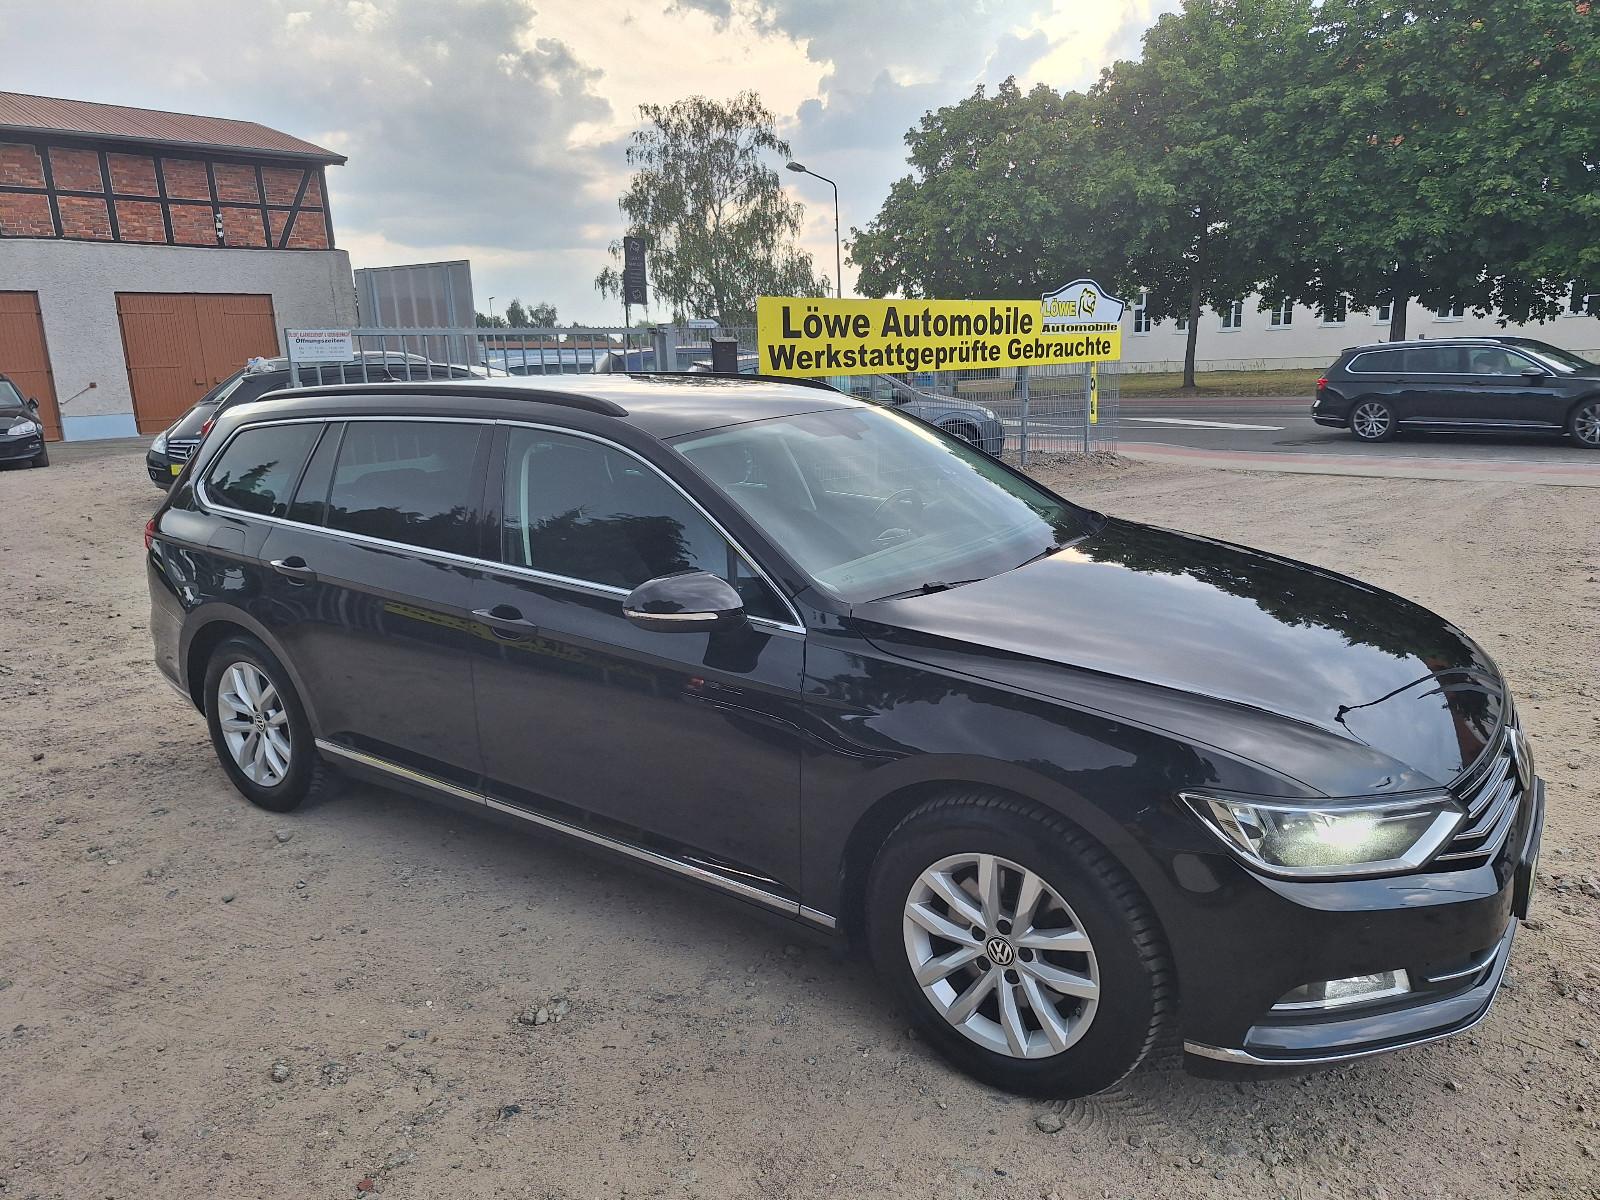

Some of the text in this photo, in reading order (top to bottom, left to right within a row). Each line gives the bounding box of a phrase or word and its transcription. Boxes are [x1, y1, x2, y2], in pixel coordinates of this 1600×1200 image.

[1042, 298, 1077, 317] LÖWE
[782, 305, 1033, 339] Löwe Automobile
[1042, 323, 1118, 333] Automobile
[767, 336, 1111, 372] Werkstattgeprüfte Gebrauchte
